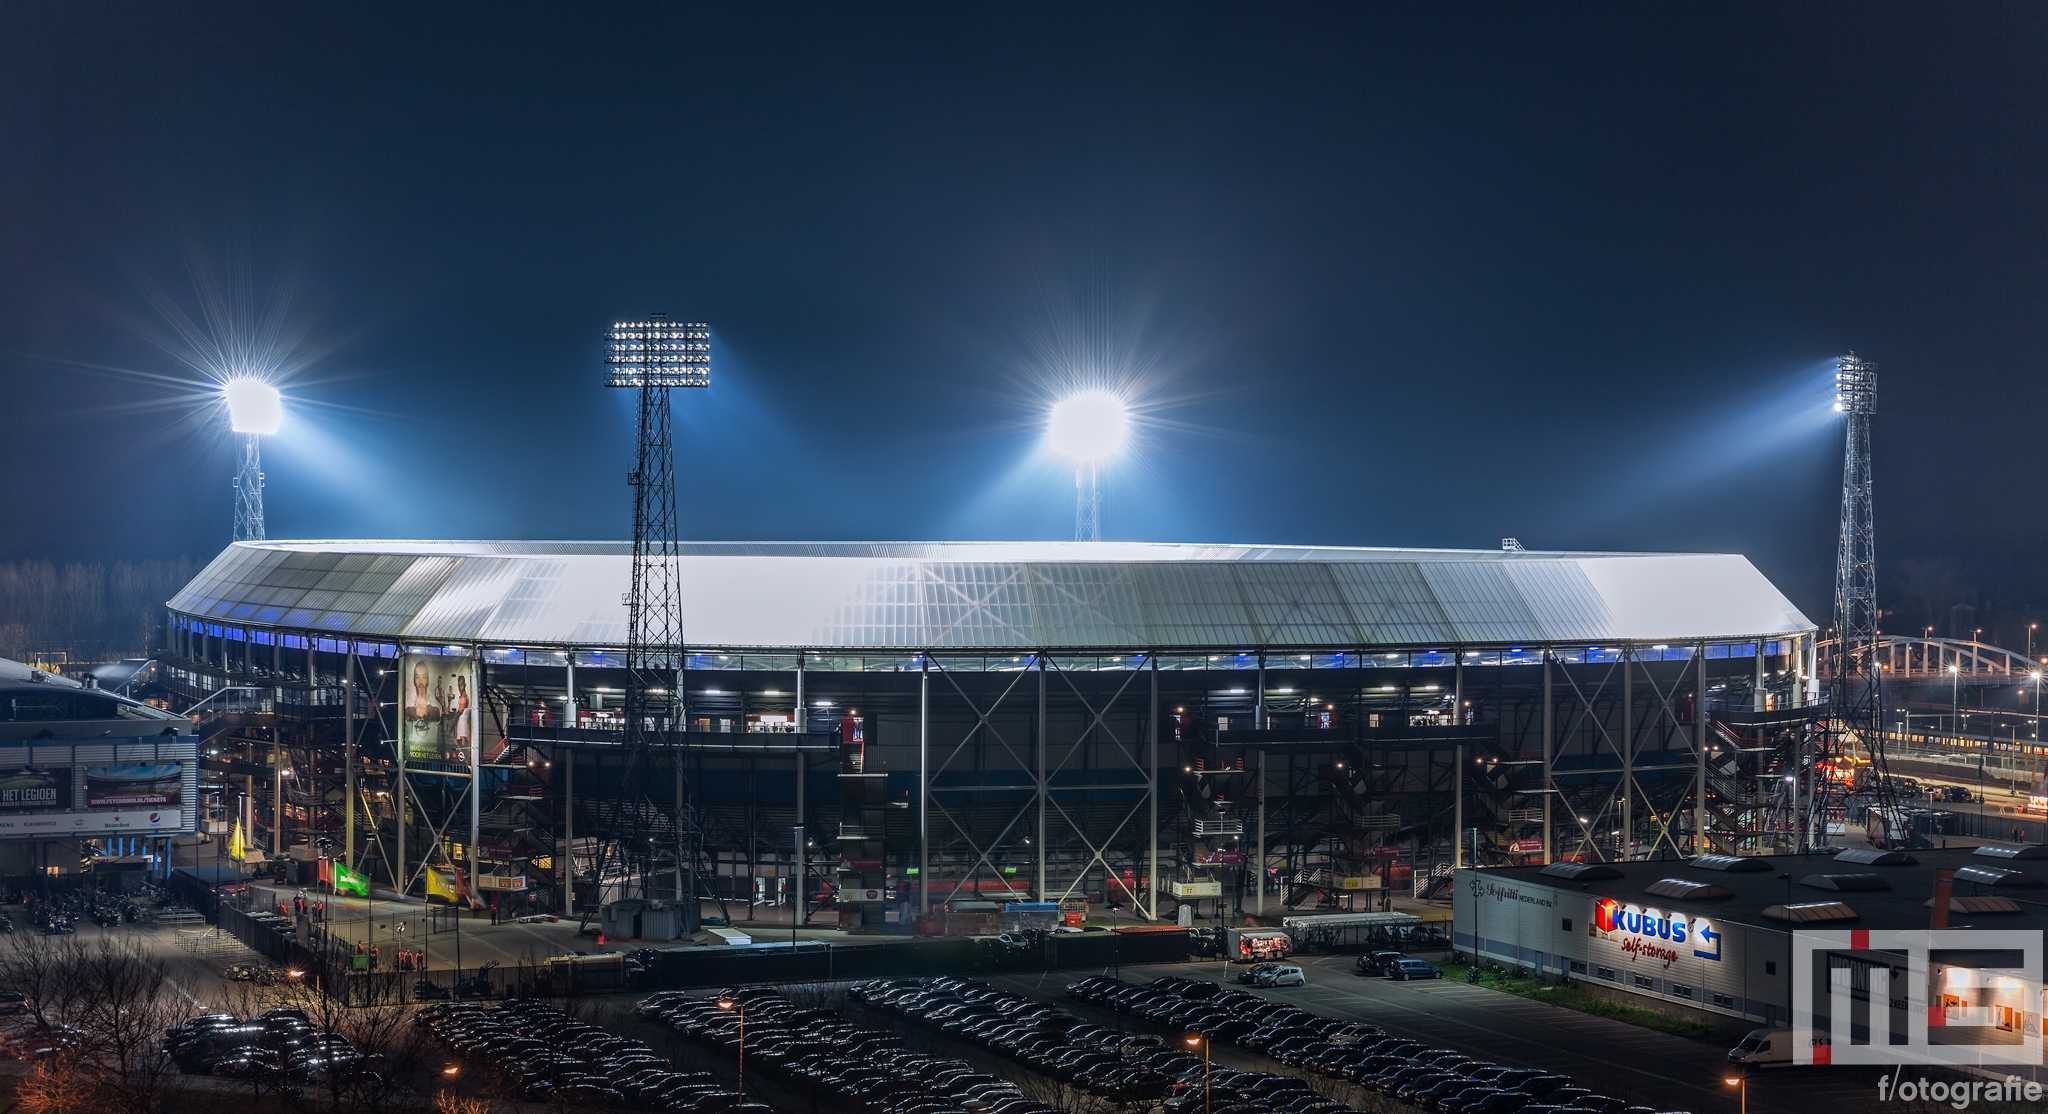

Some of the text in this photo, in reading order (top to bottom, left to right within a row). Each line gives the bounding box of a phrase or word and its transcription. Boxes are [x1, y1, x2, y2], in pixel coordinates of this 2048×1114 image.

[3, 788, 57, 802] HET LEGIOEN
[91, 796, 167, 805] WWW.FEYENOORD.NL/TICKETS
[1518, 895, 1546, 907] NEDERLAND
[1612, 909, 1686, 943] KUBUS
[1829, 955, 1886, 995] WOONING
[1893, 999, 1908, 1011] KEER
[1909, 1001, 1927, 1015] LINKS
